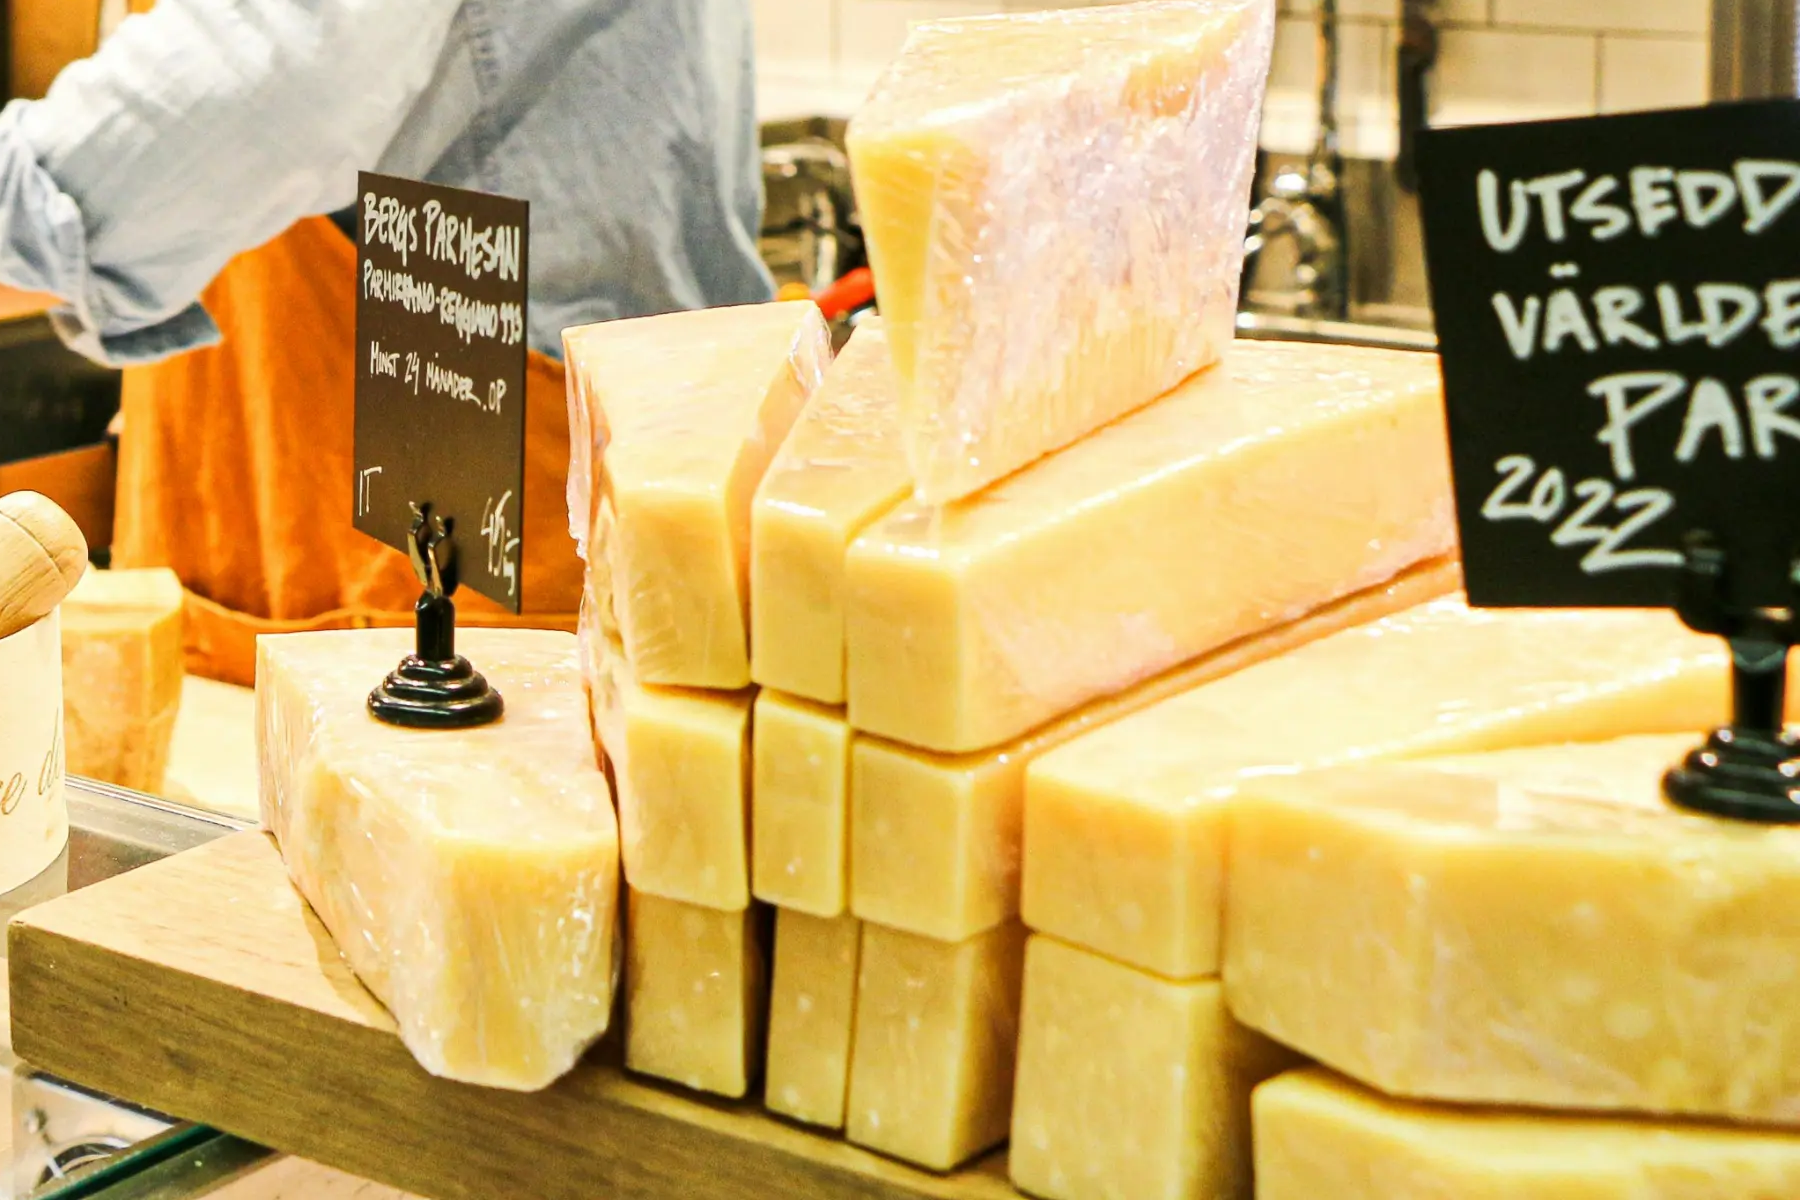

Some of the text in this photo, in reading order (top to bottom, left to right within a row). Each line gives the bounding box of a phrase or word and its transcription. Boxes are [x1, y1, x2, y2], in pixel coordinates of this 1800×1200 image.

[363, 191, 520, 282] BERGS PARMESAN
[370, 340, 401, 379] MINST
[404, 351, 420, 396] 24
[358, 466, 383, 517] IT
[1481, 455, 1686, 575] 2022
